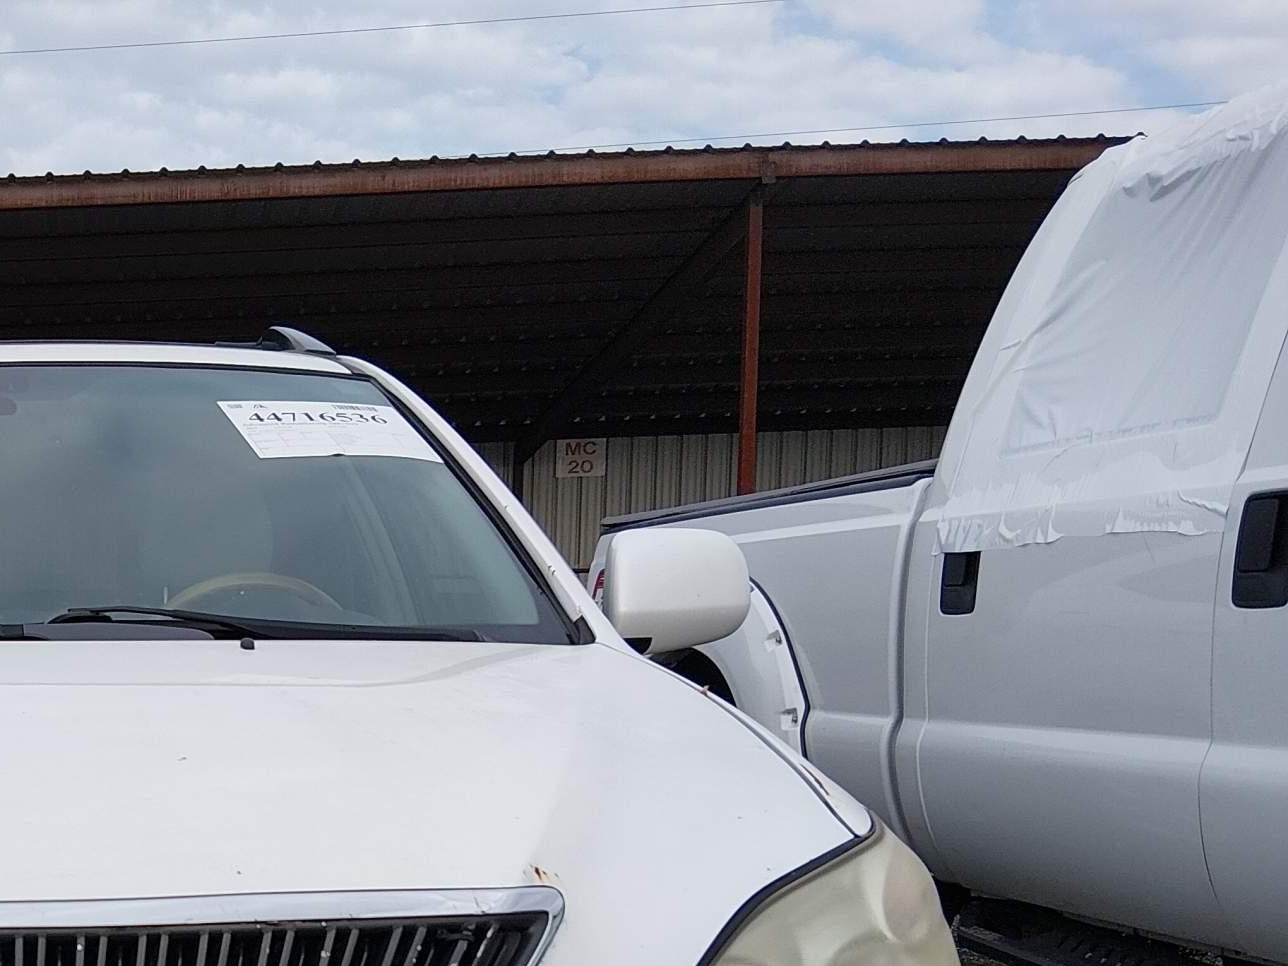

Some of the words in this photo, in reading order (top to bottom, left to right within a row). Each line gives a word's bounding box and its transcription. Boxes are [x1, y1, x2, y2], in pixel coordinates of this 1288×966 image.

[248, 411, 388, 425] 44716536
[565, 441, 597, 456] MC
[567, 459, 593, 473] 20
